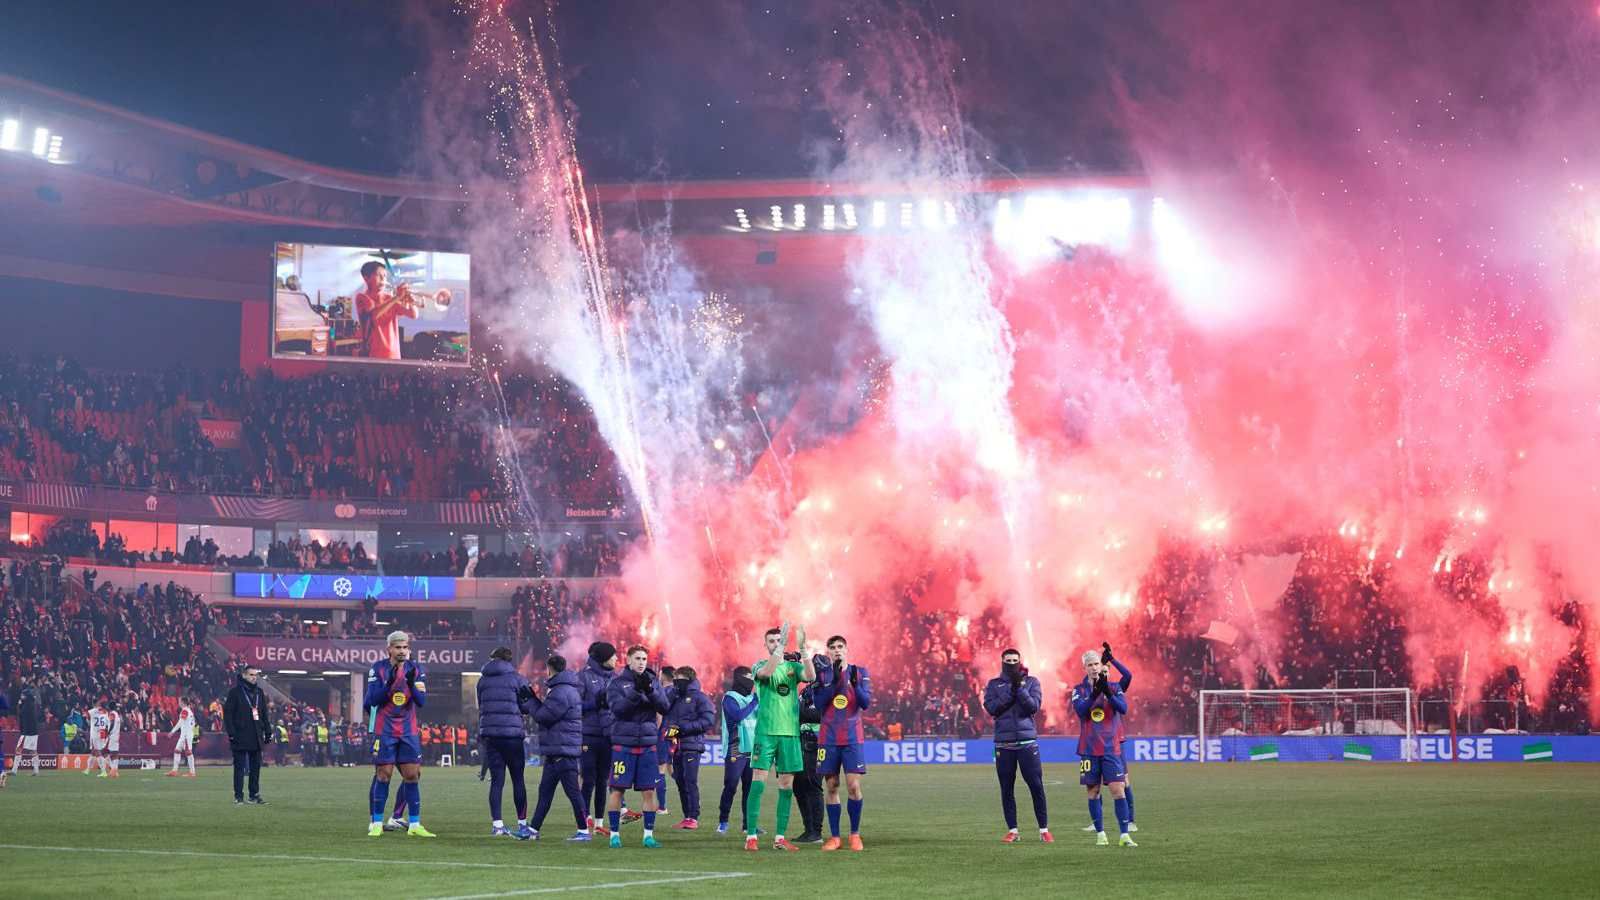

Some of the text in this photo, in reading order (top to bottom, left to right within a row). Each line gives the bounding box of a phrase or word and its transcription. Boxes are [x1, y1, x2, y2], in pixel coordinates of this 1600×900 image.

[358, 506, 408, 516] mastercard
[566, 507, 608, 517] Heineken
[255, 646, 474, 664] UEFA CHAMPION EAGUE
[94, 716, 105, 727] 26
[373, 739, 380, 752] 4
[1134, 739, 1223, 761] REUSE
[1400, 738, 1493, 760] REUSE
[884, 742, 967, 763] REUSE
[613, 760, 626, 774] 16
[1079, 759, 1091, 772] 20
